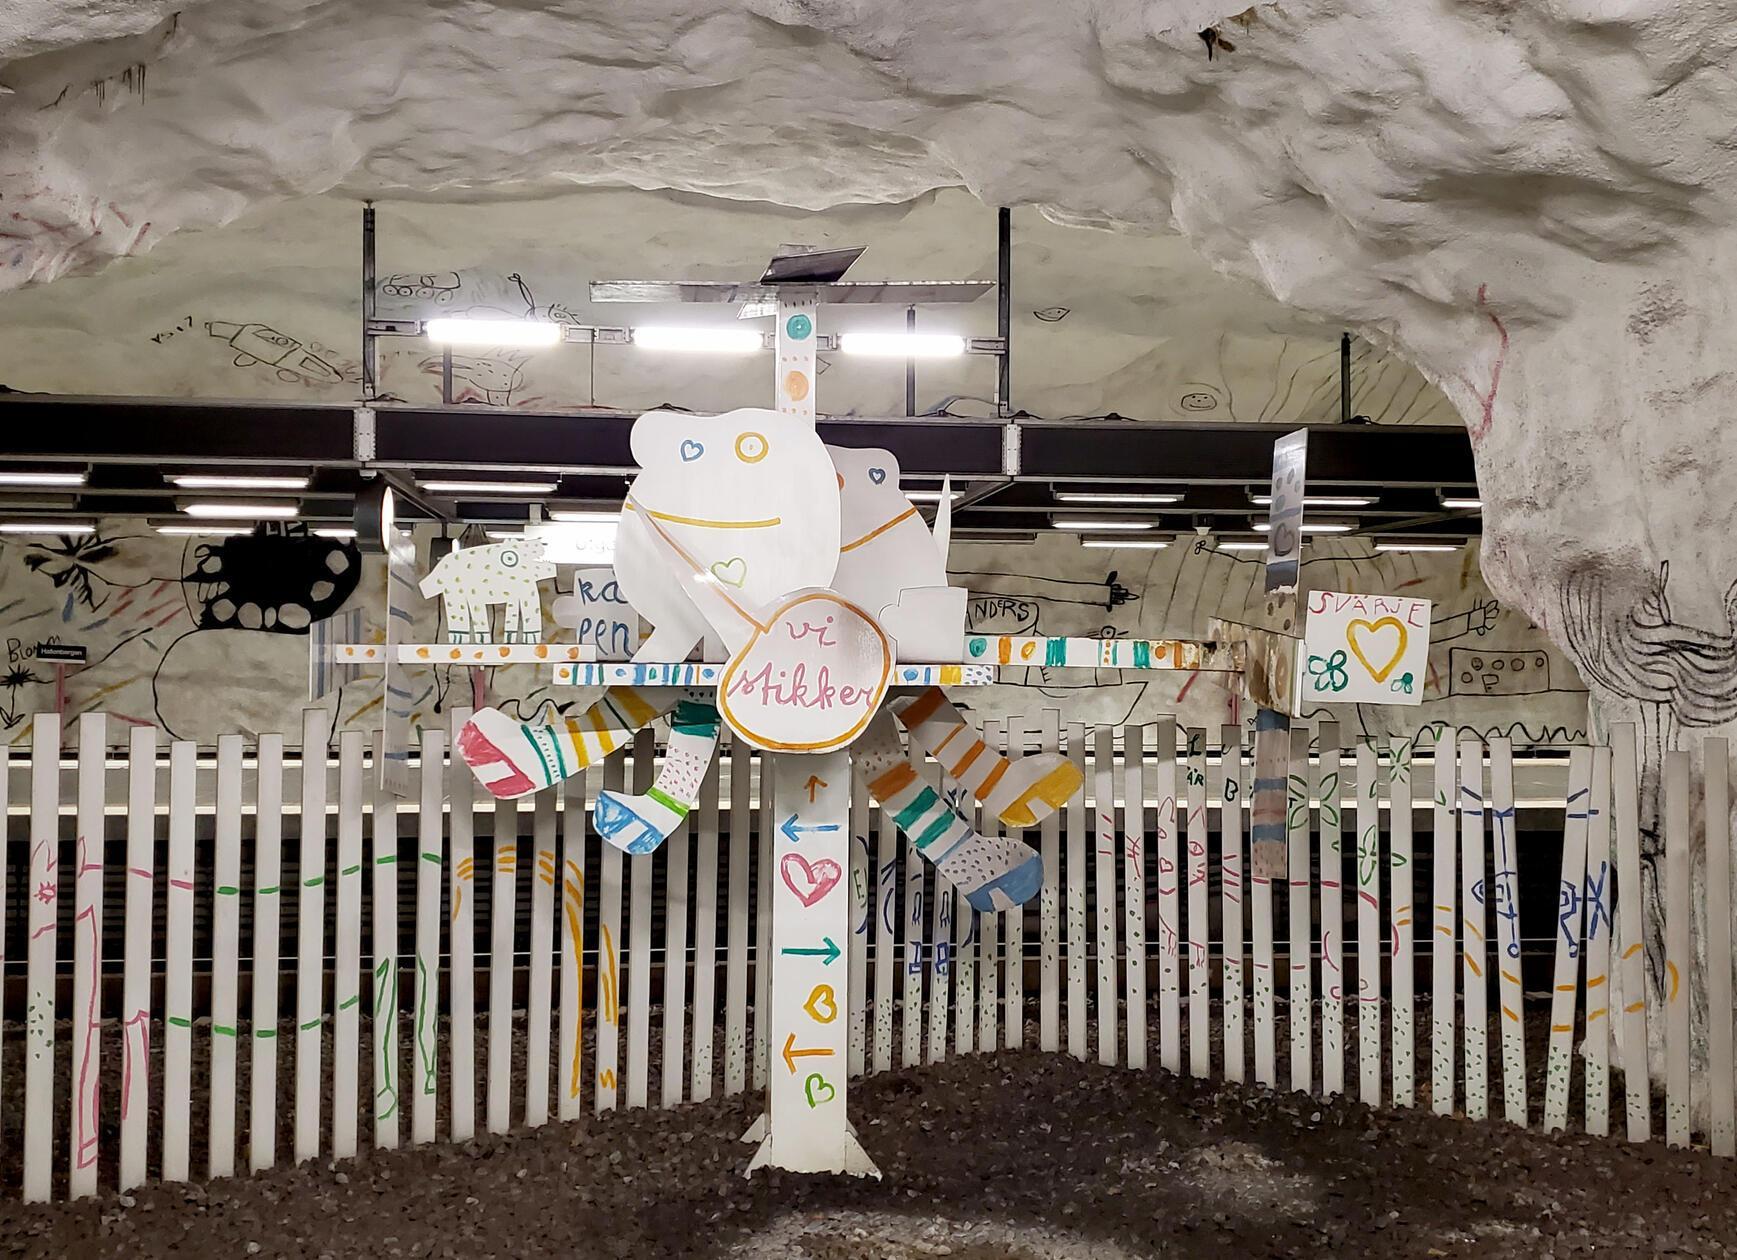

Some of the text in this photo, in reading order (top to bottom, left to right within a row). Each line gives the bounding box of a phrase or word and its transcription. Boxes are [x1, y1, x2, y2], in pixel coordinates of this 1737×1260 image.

[579, 617, 635, 657] pen
[786, 615, 836, 648] vi
[727, 662, 874, 710] stikker
